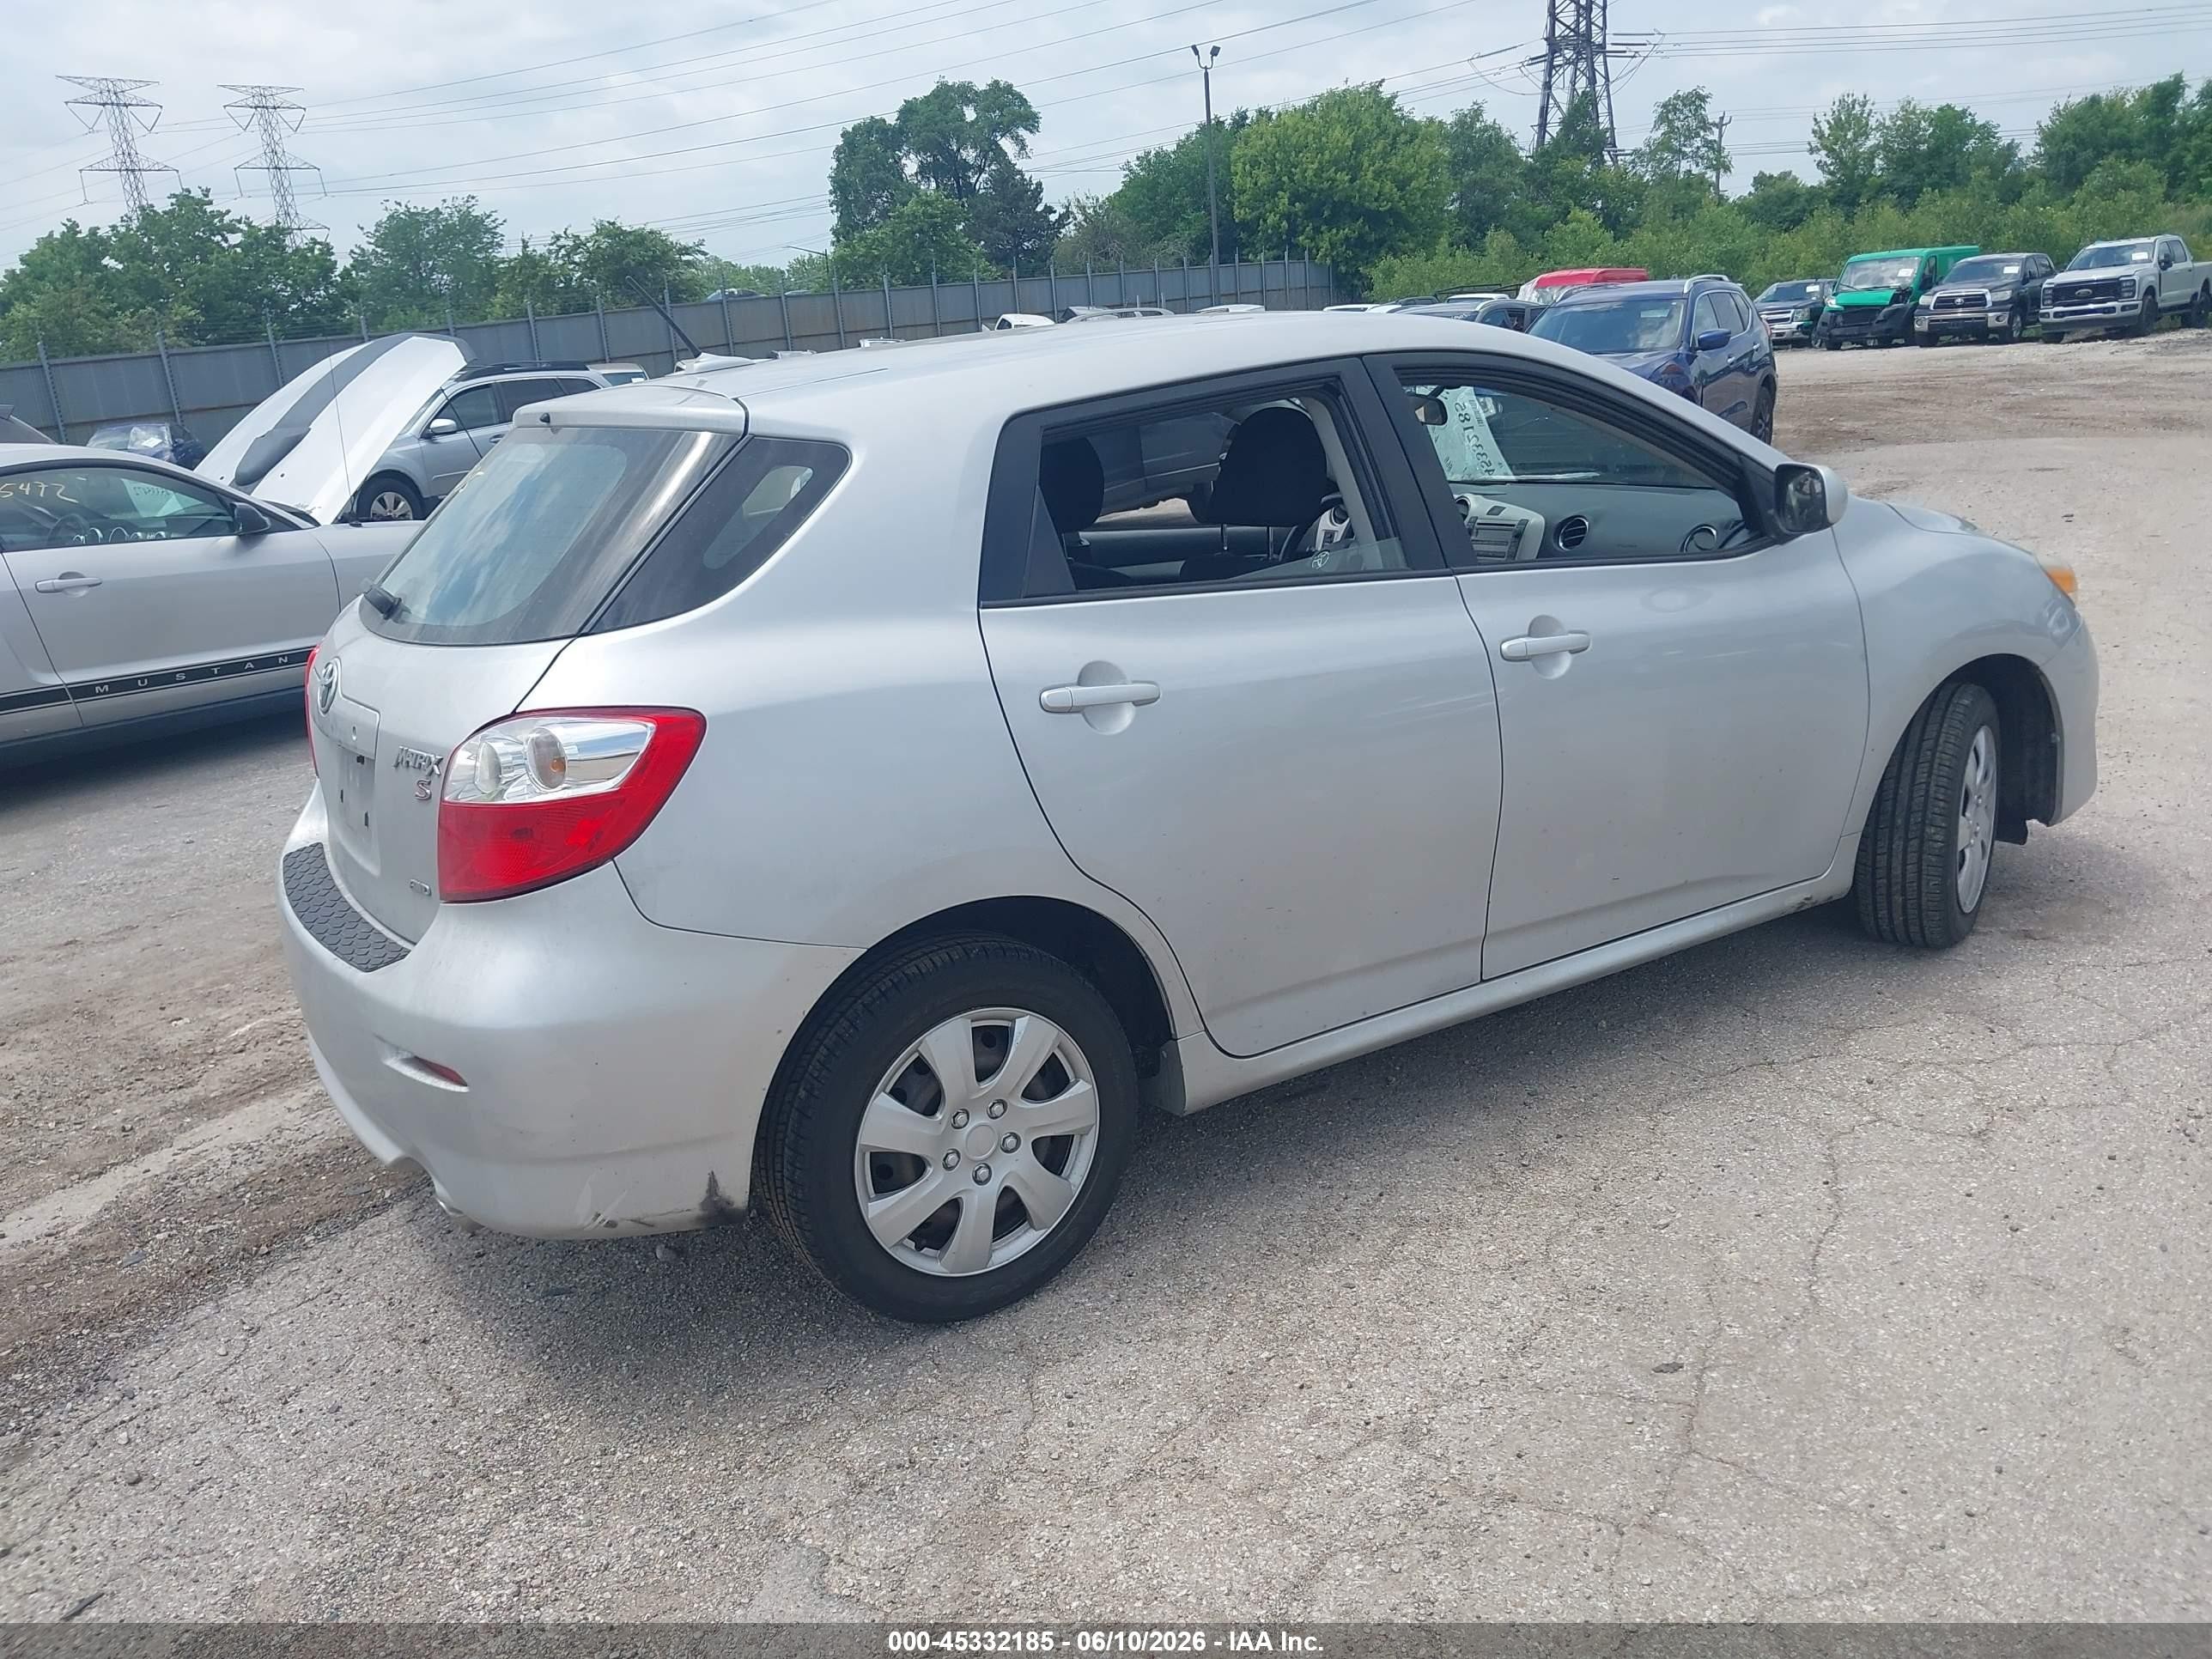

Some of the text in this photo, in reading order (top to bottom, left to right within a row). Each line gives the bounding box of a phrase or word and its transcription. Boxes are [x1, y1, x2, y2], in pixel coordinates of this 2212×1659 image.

[0, 481, 79, 504] 5472
[94, 655, 289, 695] MUSTAN
[415, 779, 433, 800] S
